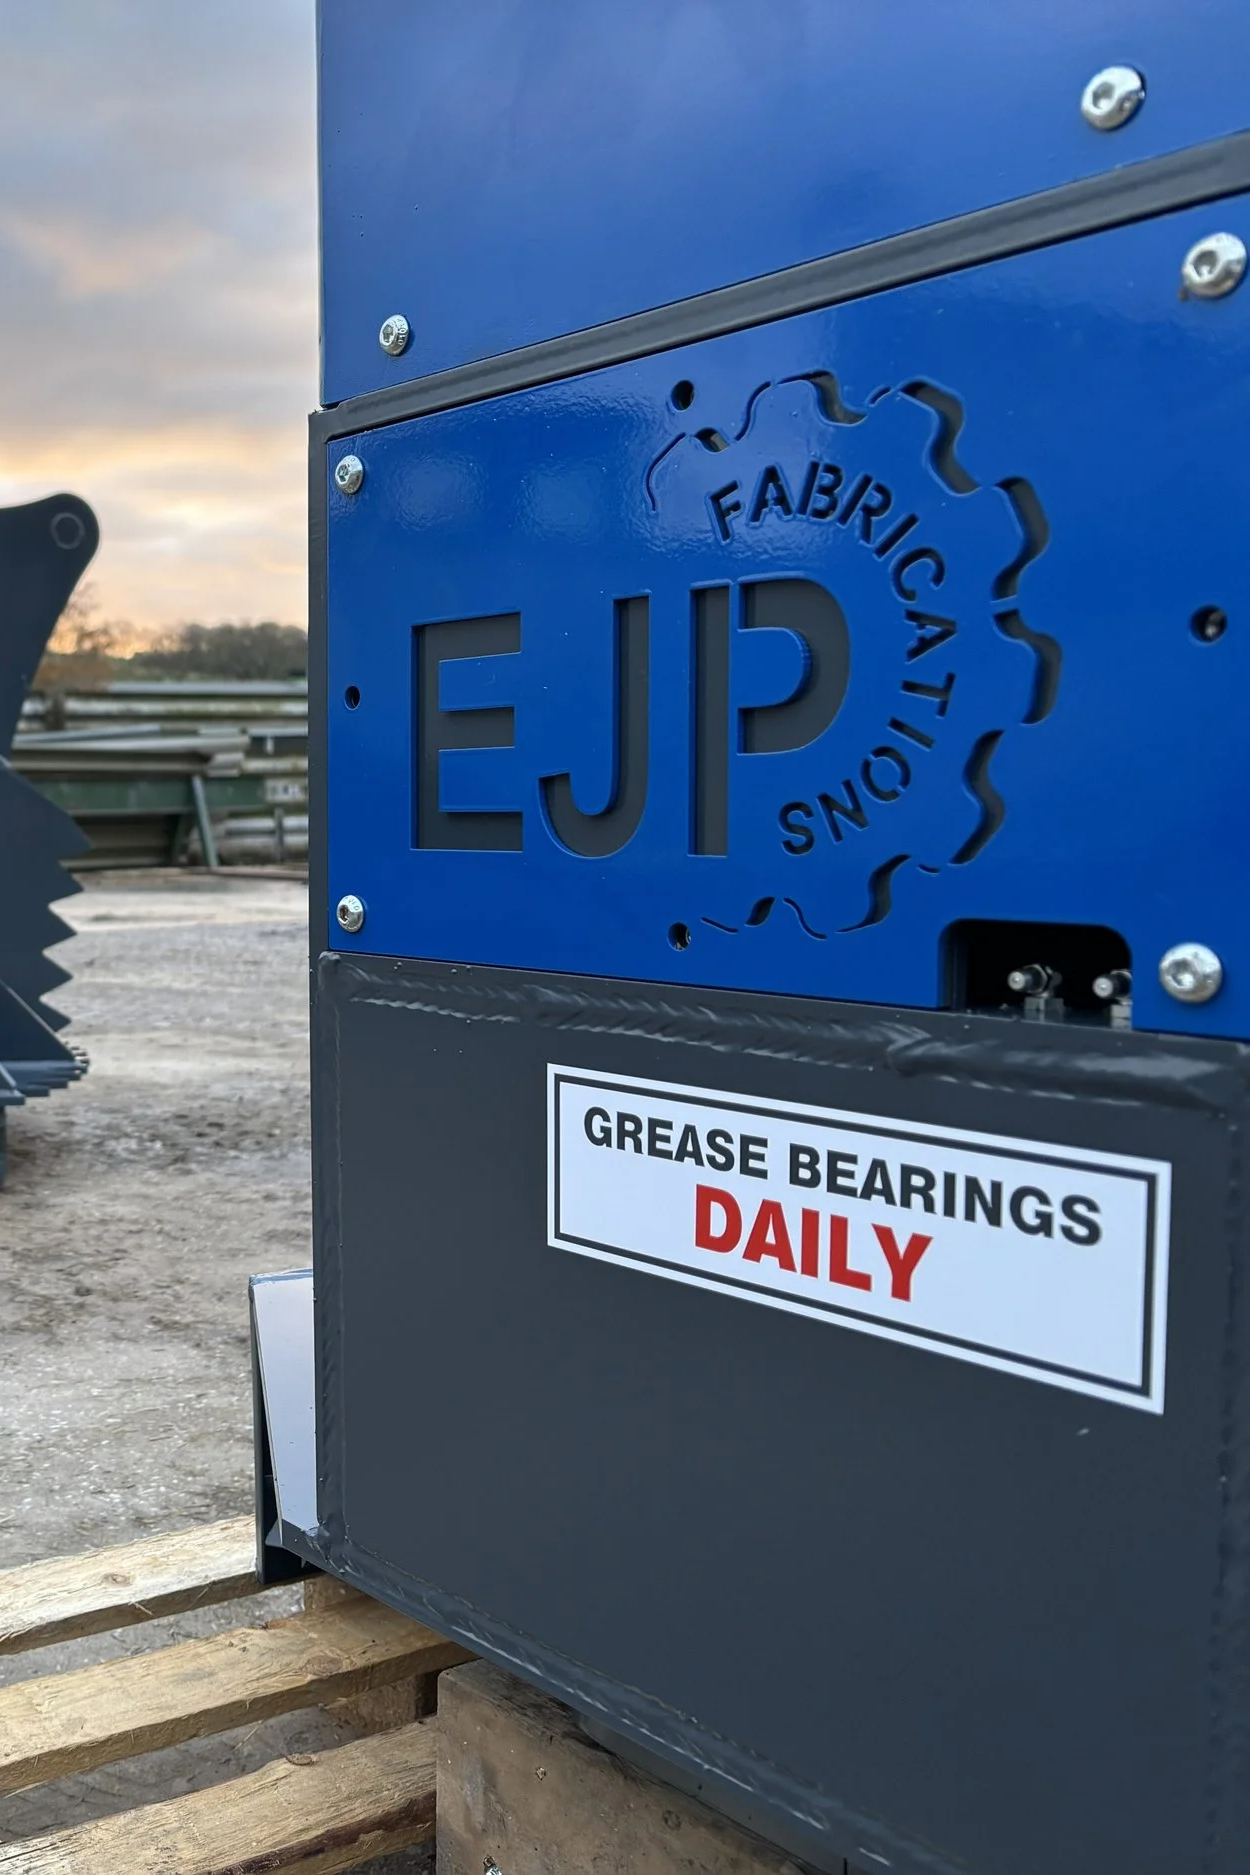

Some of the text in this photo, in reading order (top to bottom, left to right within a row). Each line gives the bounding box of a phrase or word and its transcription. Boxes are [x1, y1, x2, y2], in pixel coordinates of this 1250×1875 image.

[410, 572, 851, 859] EJP
[707, 460, 958, 857] FABRICATIONS
[583, 1105, 1103, 1247] GREASE BEARINGS
[693, 1184, 934, 1303] DAILY
